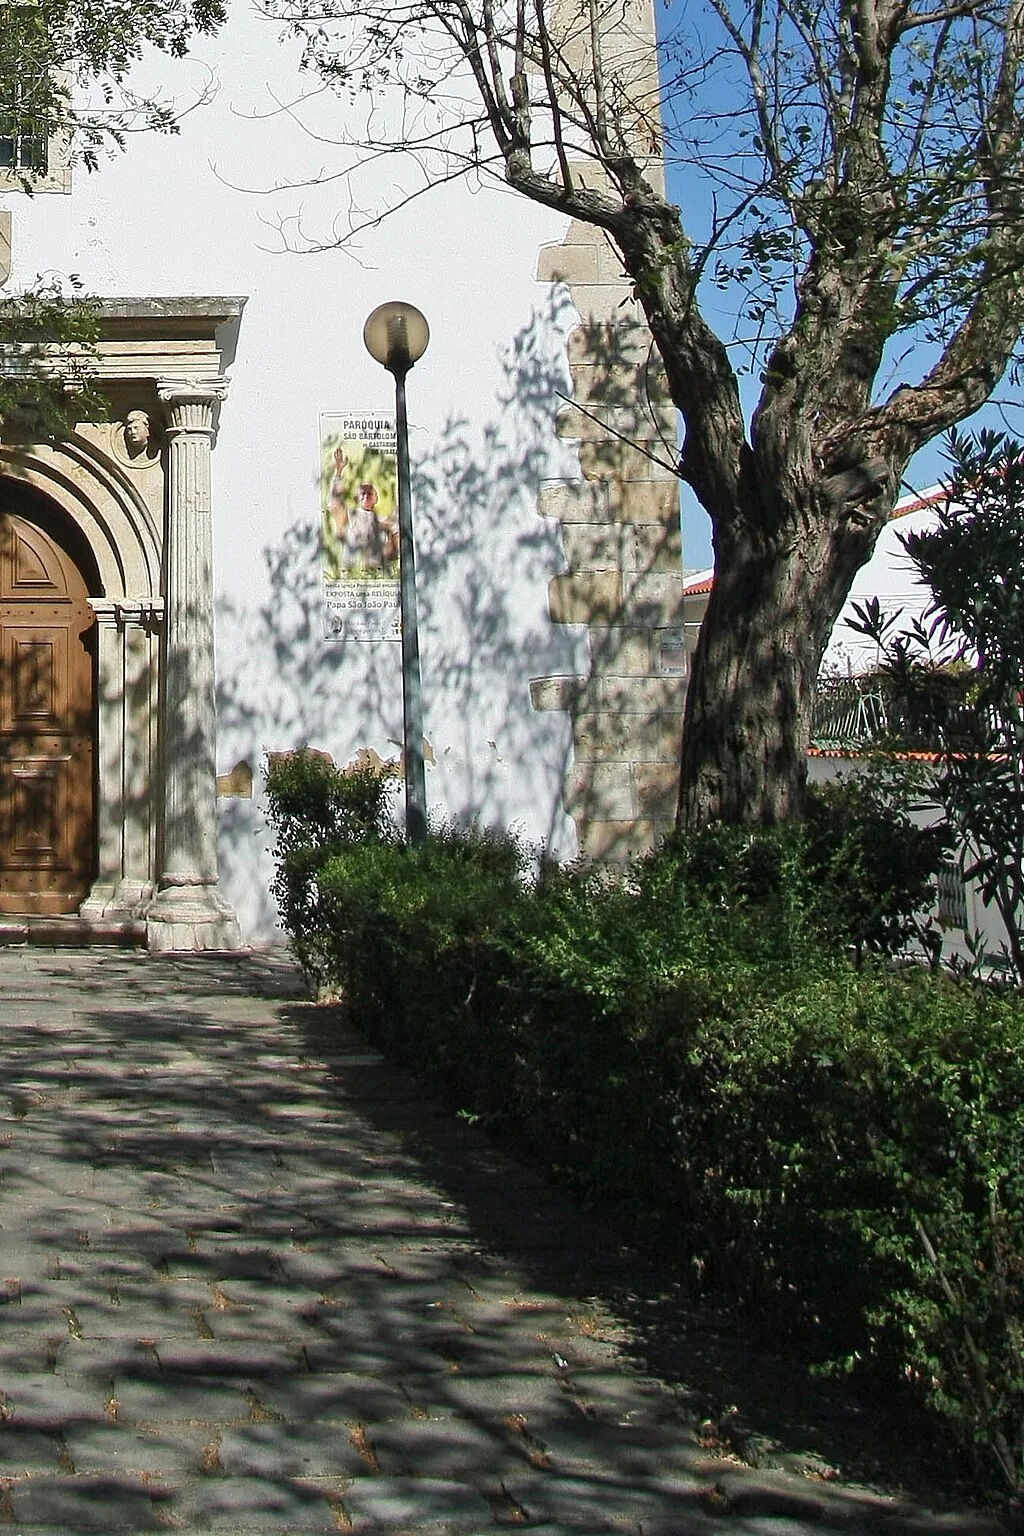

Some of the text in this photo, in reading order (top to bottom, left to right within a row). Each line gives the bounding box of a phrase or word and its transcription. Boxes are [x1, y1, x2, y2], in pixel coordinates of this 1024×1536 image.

[343, 418, 390, 430] PARÓQUIA
[343, 431, 397, 440] SÃO BARTOLOM
[327, 600, 400, 611] Papa São João Paul
